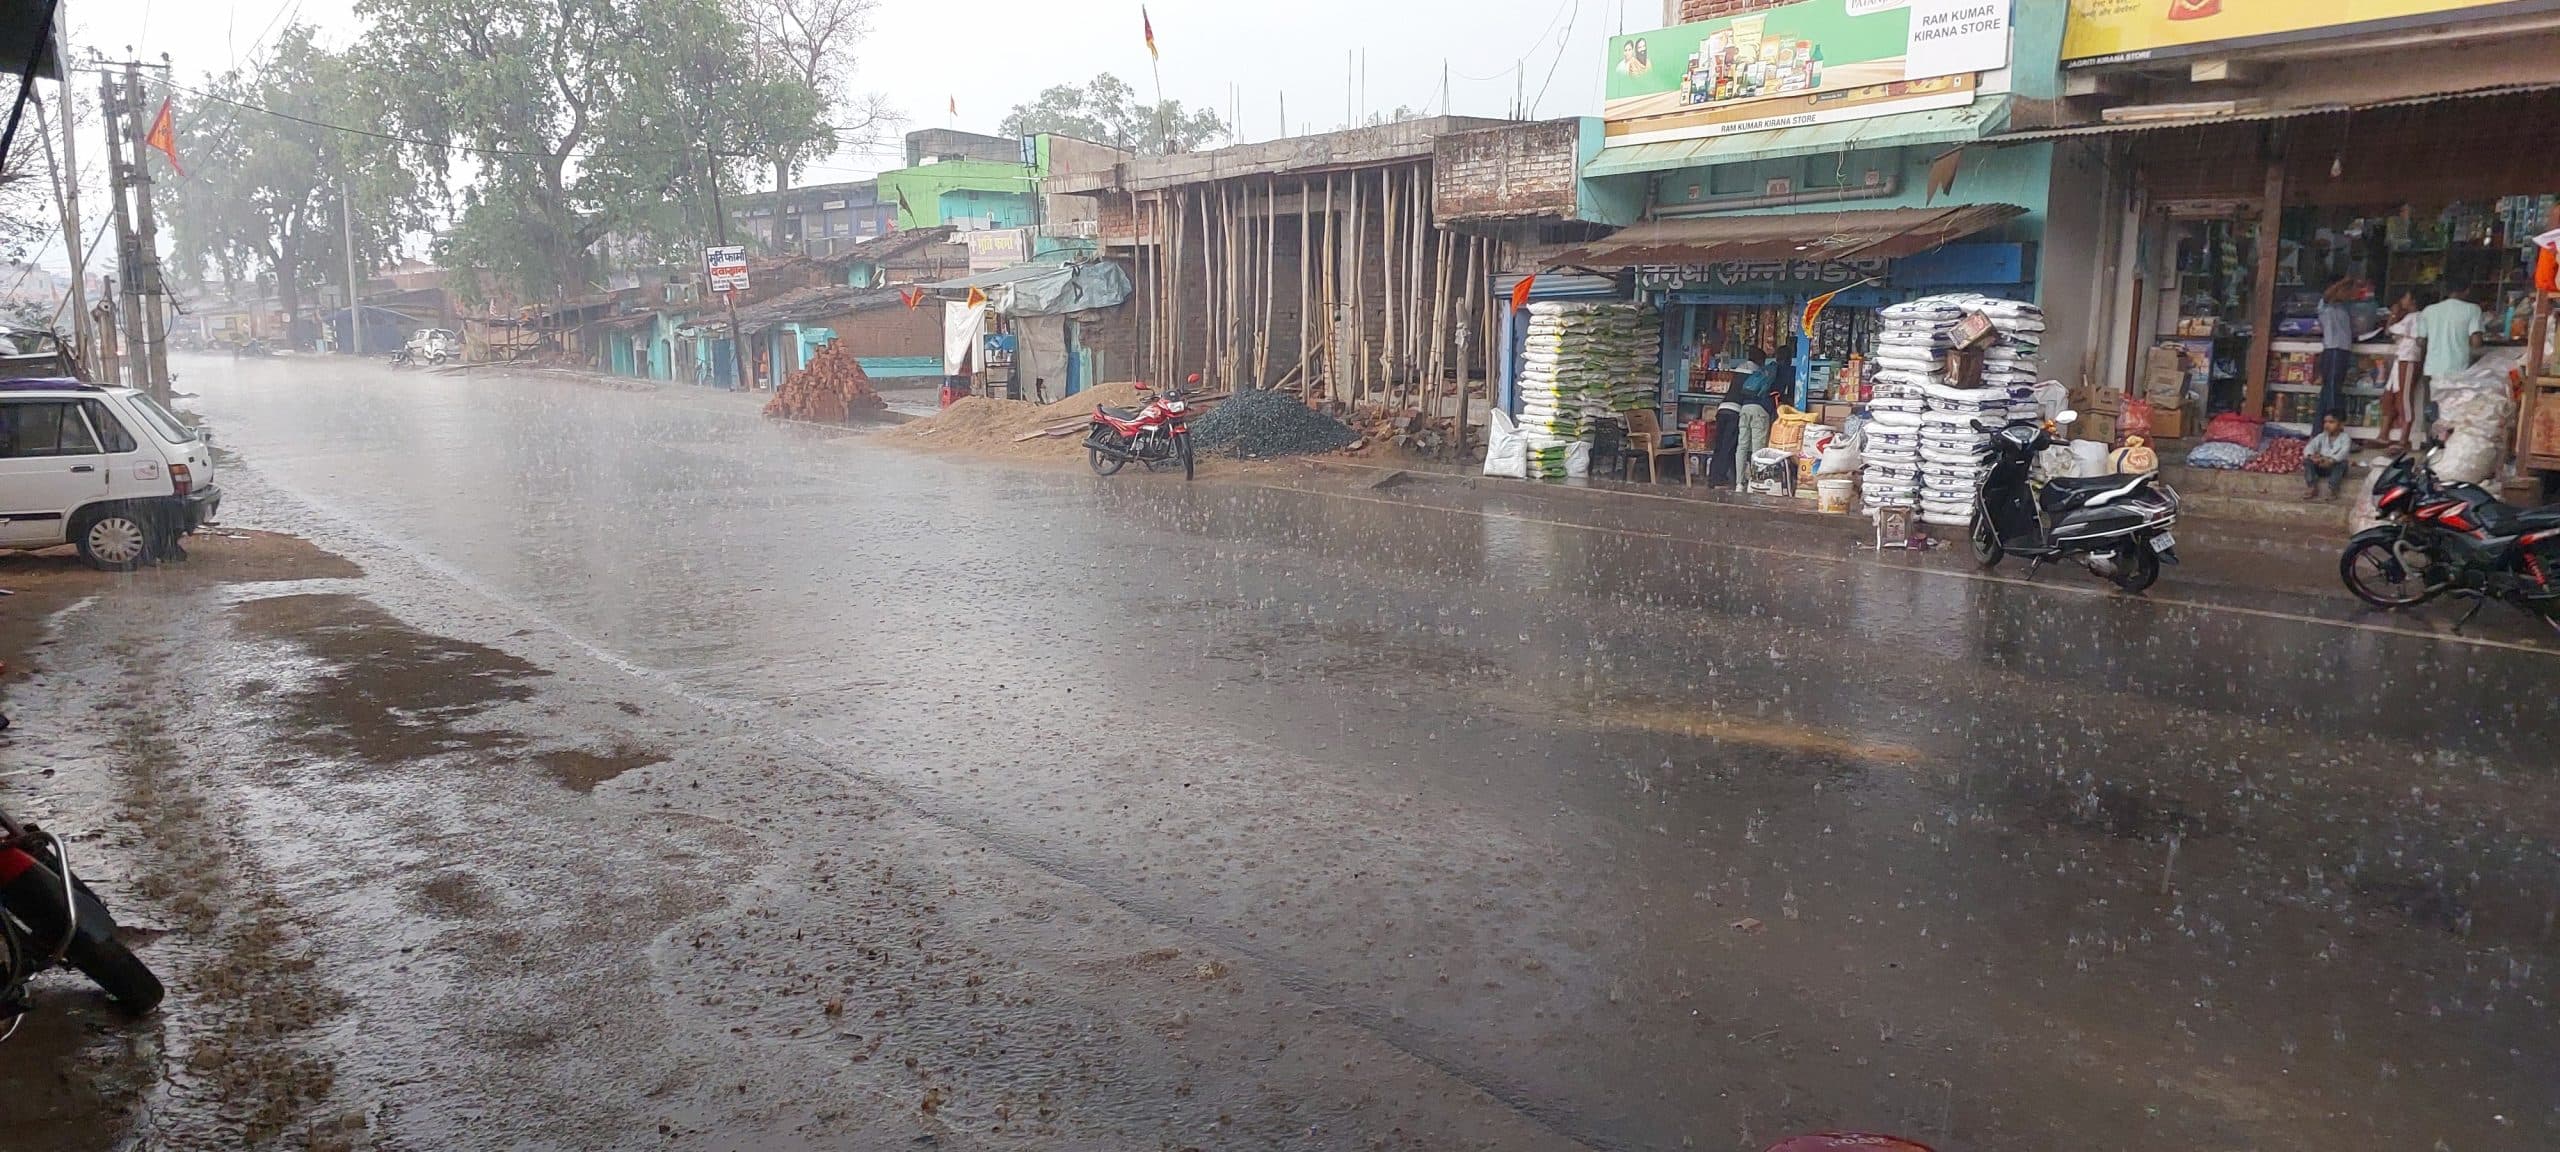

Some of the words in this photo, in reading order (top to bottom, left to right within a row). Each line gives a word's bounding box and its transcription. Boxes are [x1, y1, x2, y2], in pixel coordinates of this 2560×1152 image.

[1922, 13, 1948, 27] RAM
[1951, 4, 1995, 21] KUMAR
[1914, 26, 1958, 42] KIRANA
[1960, 18, 2001, 35] STORE
[2067, 57, 2096, 69] JAGRITI
[2096, 54, 2125, 65] KIRANA
[2125, 50, 2152, 61] STORE
[1720, 124, 1737, 133] RAM
[1737, 120, 1763, 132] KUMAR
[1763, 118, 1791, 128] KIRANA
[1792, 114, 1817, 125] STORE
